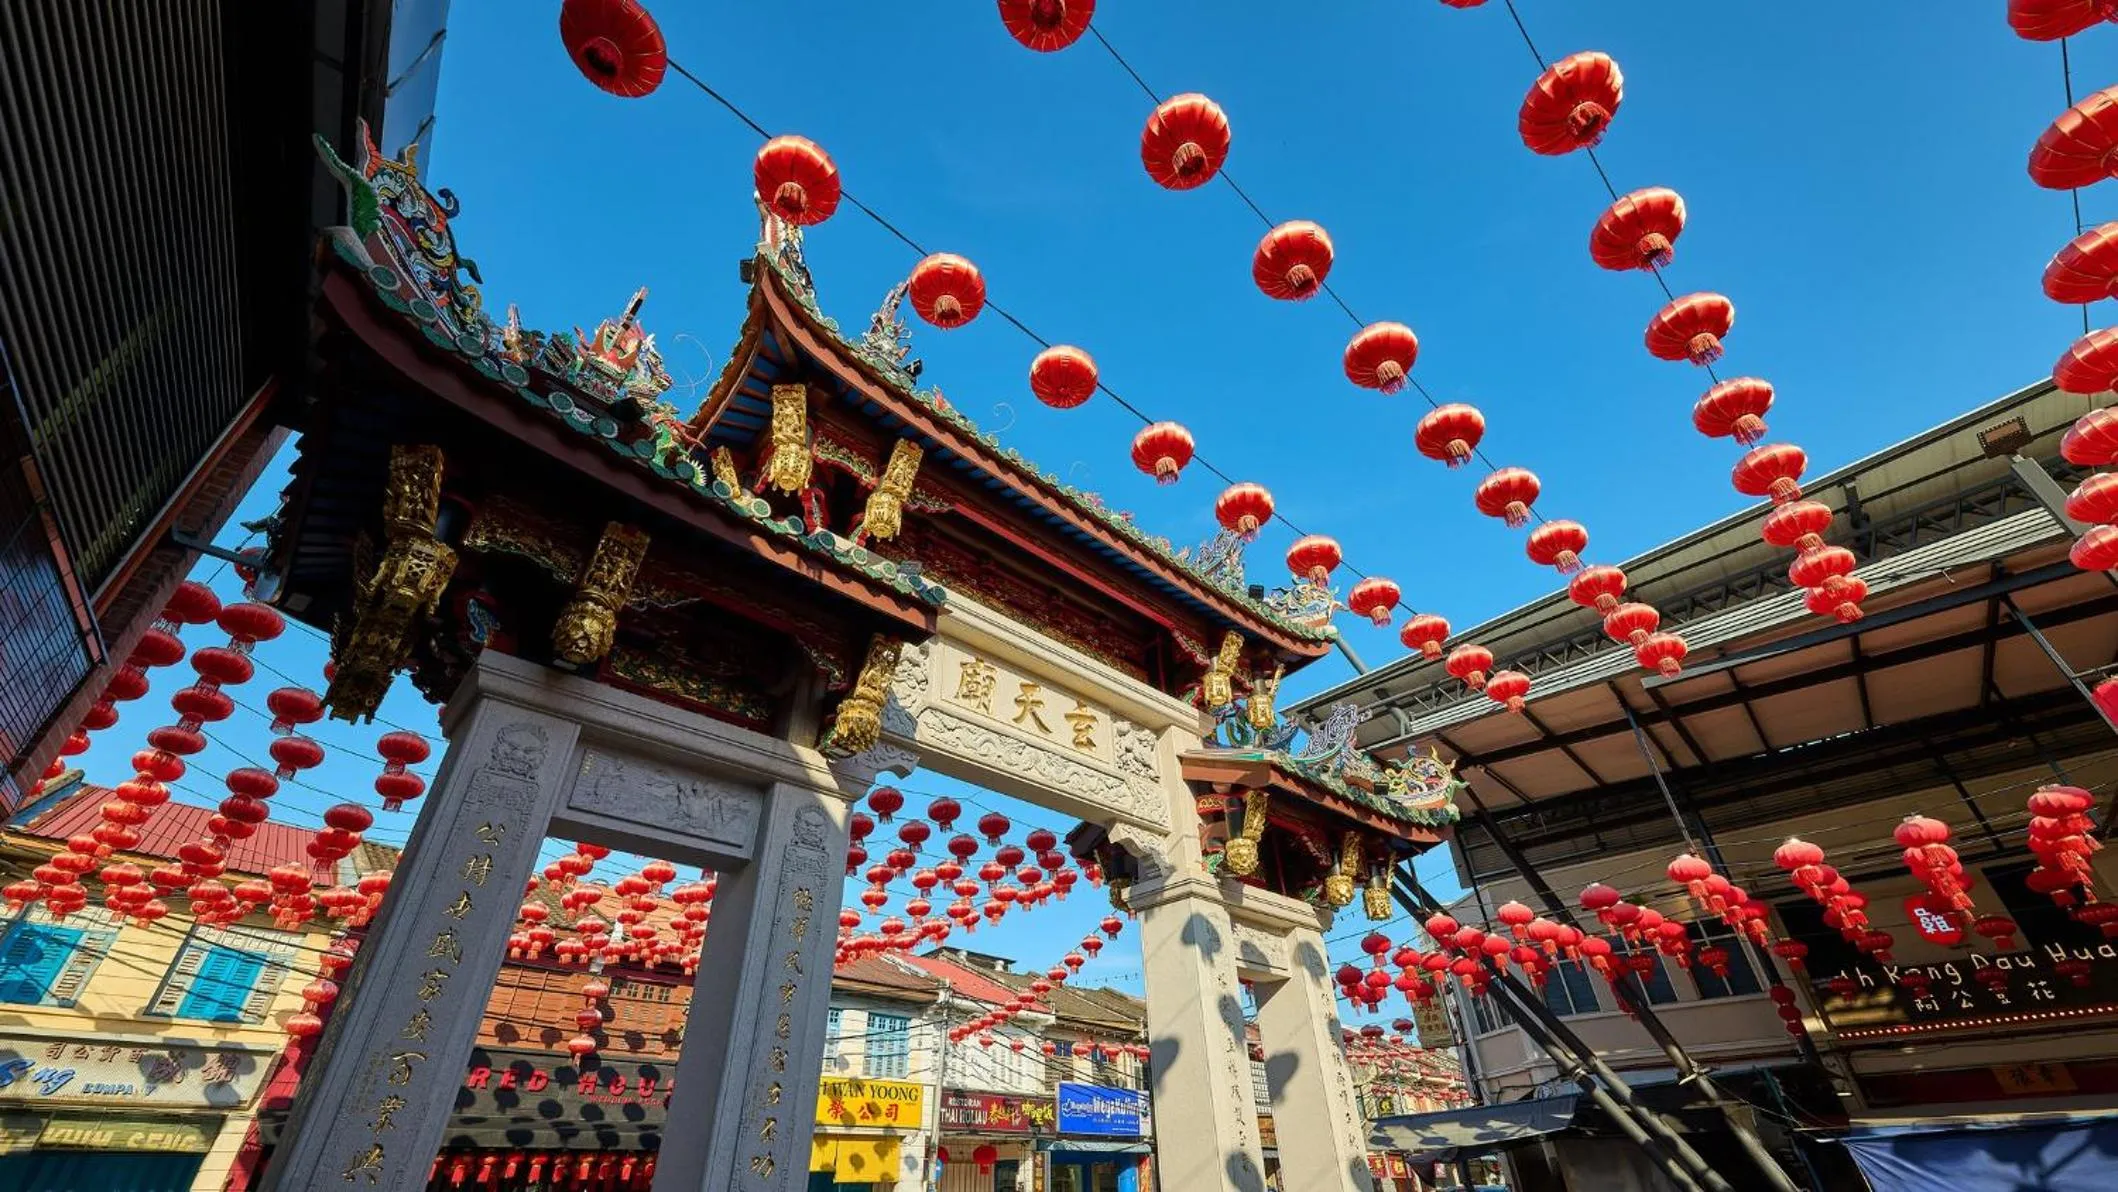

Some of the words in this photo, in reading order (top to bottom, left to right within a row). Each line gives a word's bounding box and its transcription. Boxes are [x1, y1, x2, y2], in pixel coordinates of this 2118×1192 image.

[1970, 953, 2036, 970] Dau
[2044, 941, 2117, 963] Hua
[467, 1066, 549, 1092] RED
[868, 1084, 919, 1102] YOONG
